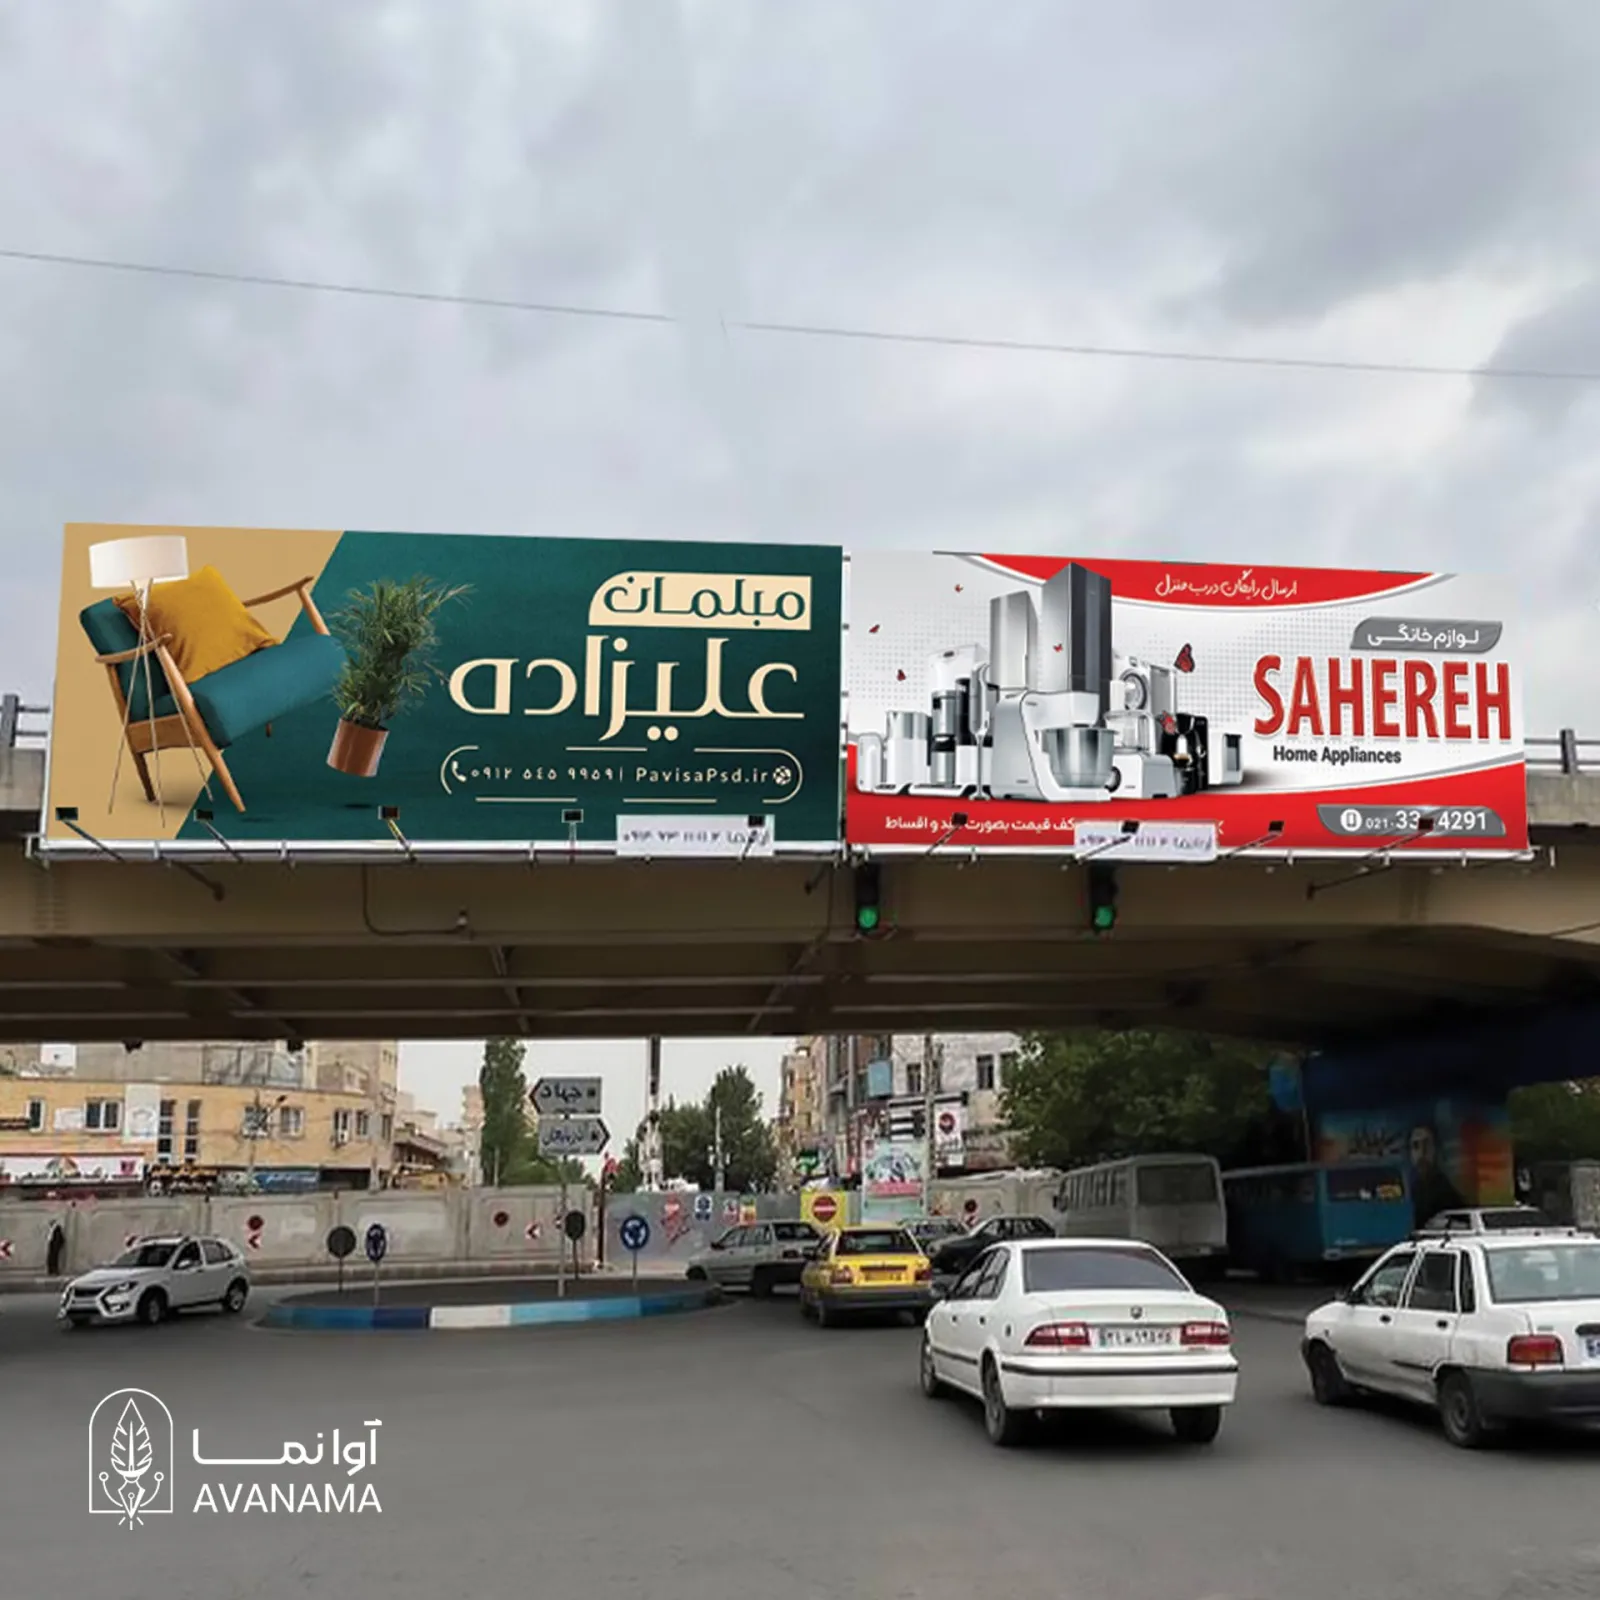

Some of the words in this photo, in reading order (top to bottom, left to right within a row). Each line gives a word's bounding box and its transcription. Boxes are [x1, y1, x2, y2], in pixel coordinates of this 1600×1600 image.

[1155, 573, 1187, 597] منزل
[1189, 581, 1219, 597] درب
[1261, 577, 1297, 600] ارسال
[604, 576, 806, 626] مبلمان
[1367, 623, 1433, 647] خانگی
[1433, 628, 1480, 650] لوازم
[449, 635, 804, 741] علیزاده
[1254, 654, 1512, 740] SAHEREH
[1273, 745, 1318, 762] Home
[1321, 746, 1402, 766] Appliances
[636, 766, 768, 783] PavisaPsd.ir
[885, 815, 928, 829] اقساط
[930, 819, 939, 834] و
[964, 818, 1010, 834] بصورت
[1011, 817, 1051, 834] قیمت
[541, 1082, 582, 1103] جهاد
